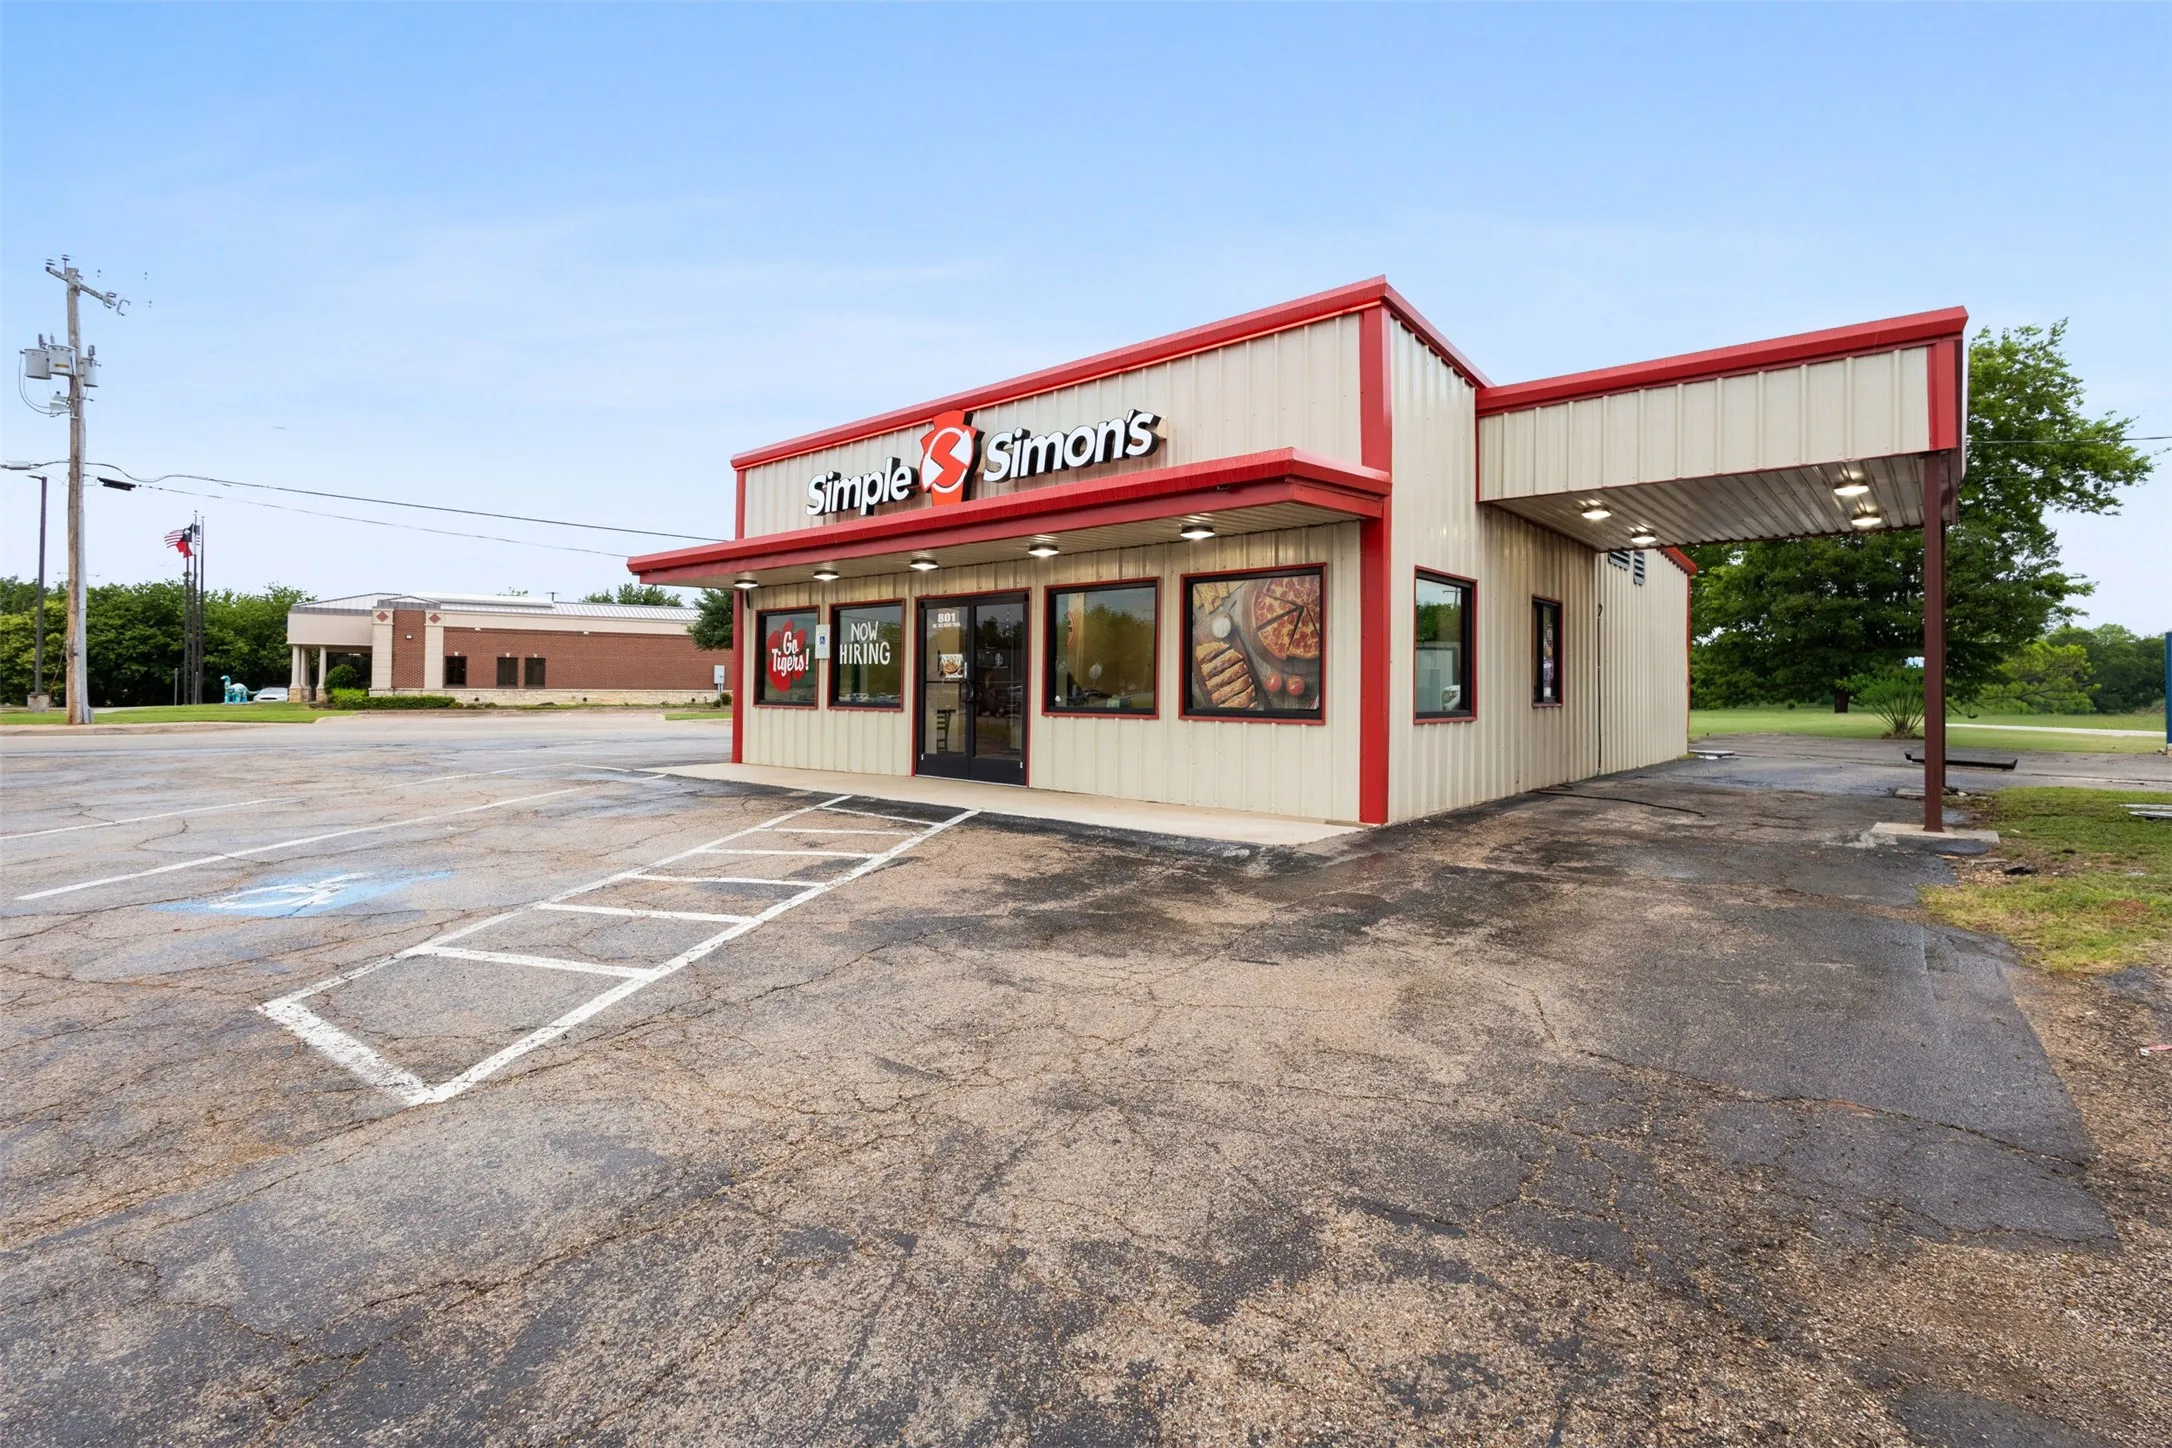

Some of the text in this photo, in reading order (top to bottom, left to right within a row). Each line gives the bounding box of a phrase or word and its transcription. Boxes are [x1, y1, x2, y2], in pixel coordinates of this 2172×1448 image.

[805, 457, 914, 516] Simple
[983, 409, 1161, 483] Simon's
[938, 612, 956, 623] 801
[783, 631, 799, 655] Go
[851, 621, 879, 641] NOW
[771, 648, 810, 677] Tigers!
[840, 641, 891, 665] HIRING
